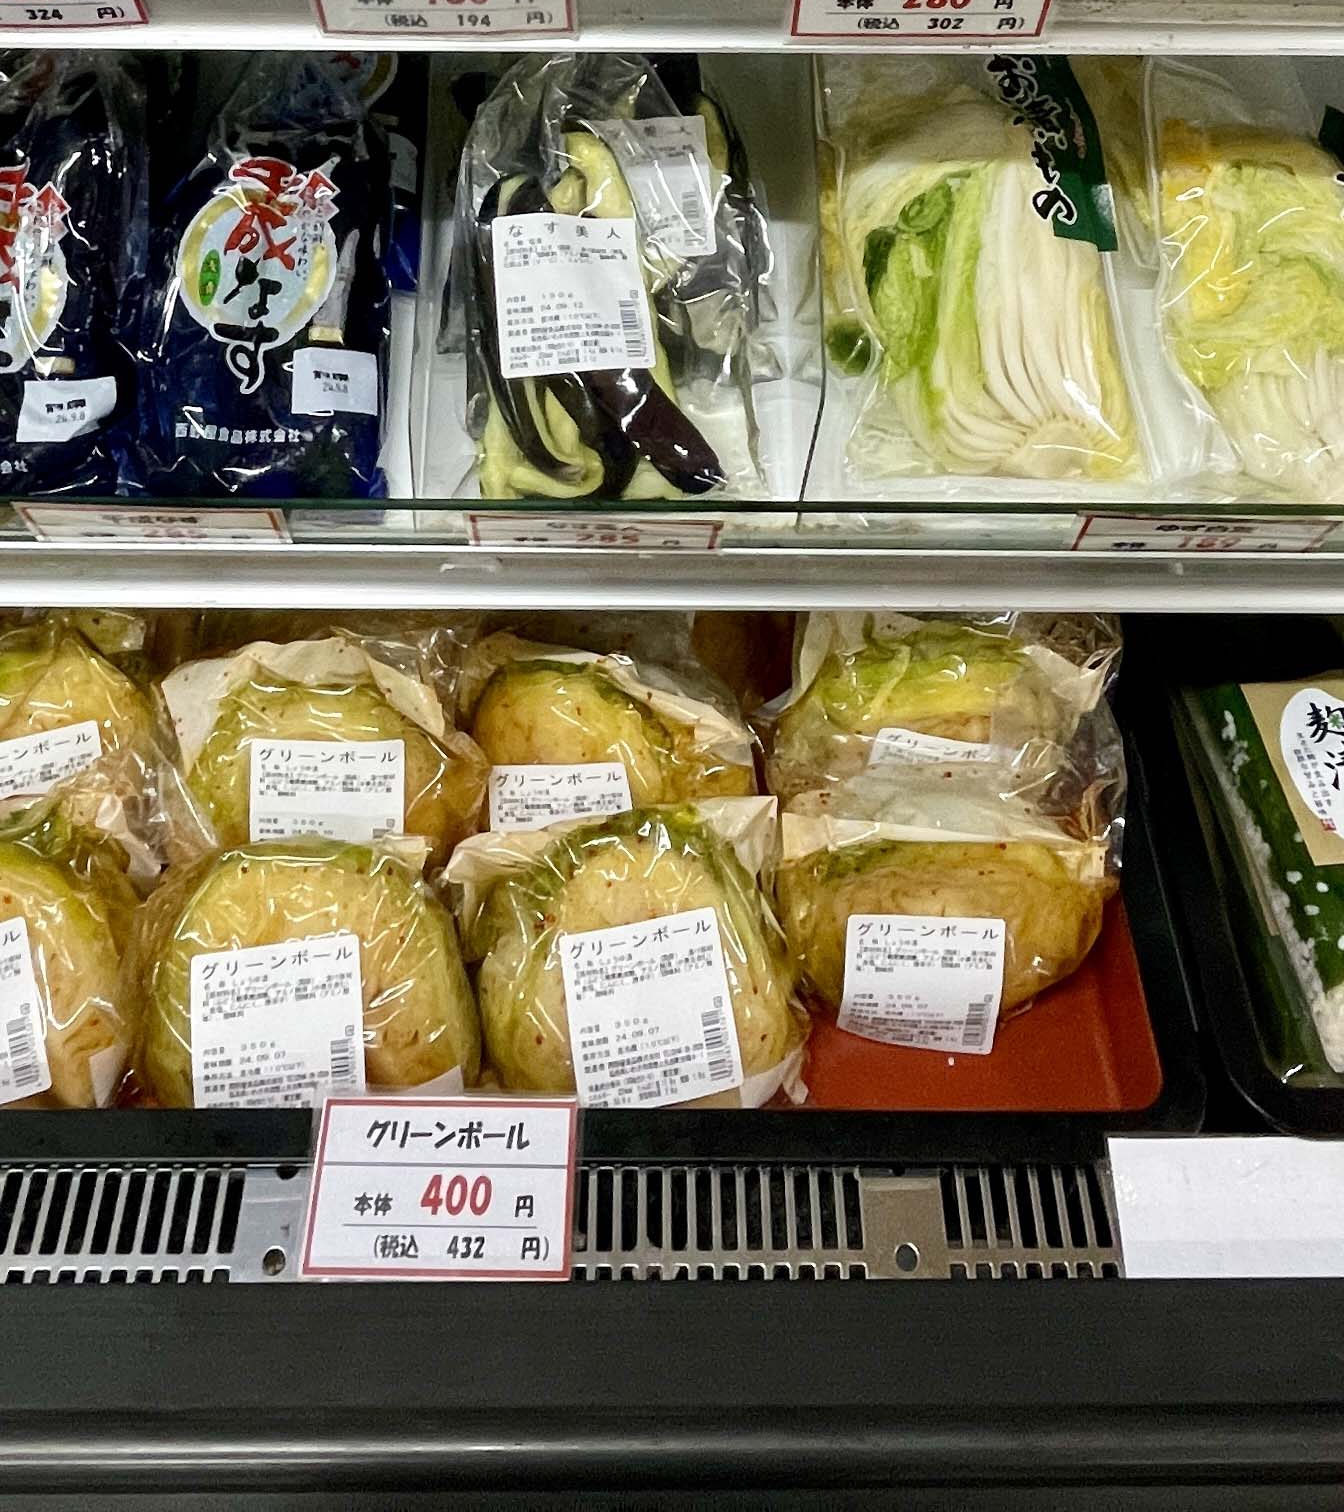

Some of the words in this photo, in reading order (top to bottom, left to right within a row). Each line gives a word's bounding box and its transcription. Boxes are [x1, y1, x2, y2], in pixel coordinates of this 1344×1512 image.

[24, 7, 65, 22] 324
[456, 13, 492, 28] 194
[526, 10, 554, 26] 円)
[926, 17, 965, 31] 302
[995, 16, 1026, 31] 円)
[508, 221, 622, 239] なす美人
[257, 744, 400, 769] グリーンボール
[494, 767, 624, 791] グリーンボール
[569, 919, 712, 960] グリーンボール
[855, 920, 1000, 944] グリーンボール
[200, 943, 354, 982] グリーンボール
[366, 1119, 531, 1150] グリーンボール
[353, 1191, 394, 1217] 本体
[420, 1173, 493, 1217] 400
[514, 1194, 535, 1218] 円
[373, 1234, 419, 1259] (税込
[446, 1235, 486, 1259] 432
[520, 1236, 550, 1261] 円)
